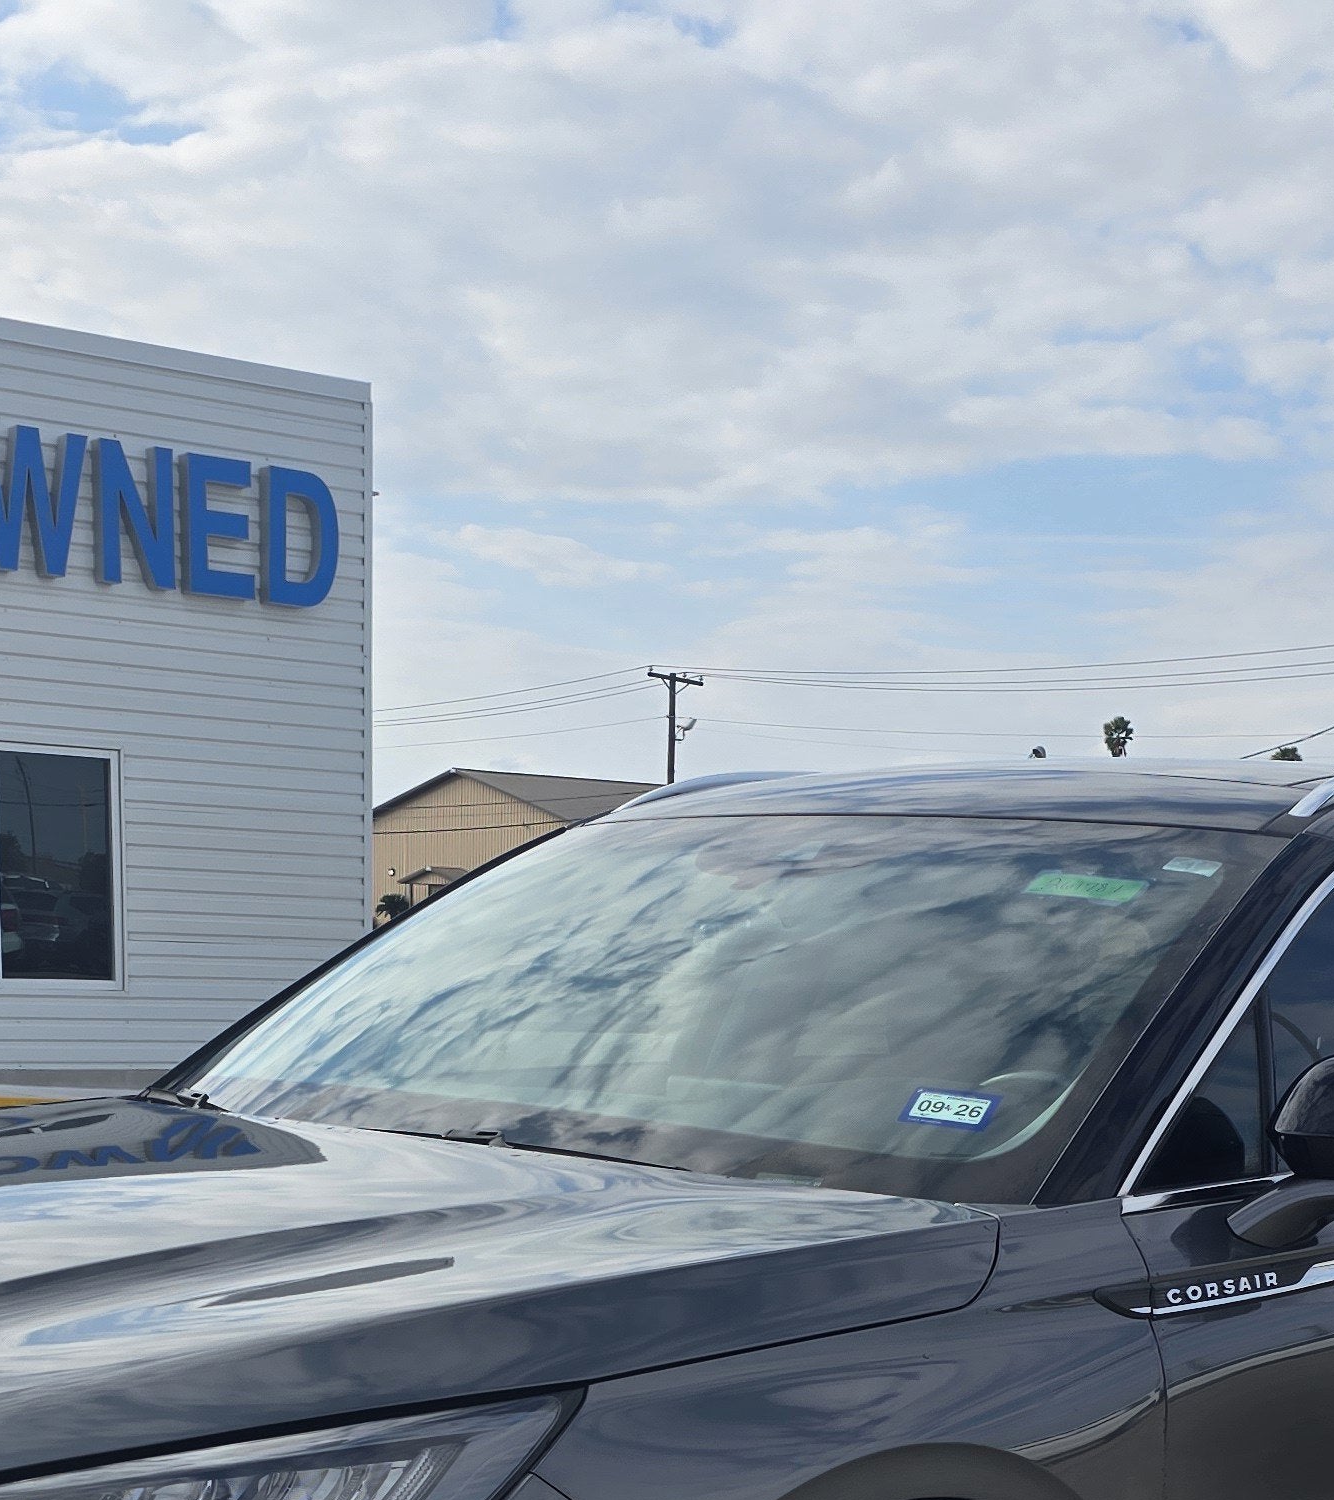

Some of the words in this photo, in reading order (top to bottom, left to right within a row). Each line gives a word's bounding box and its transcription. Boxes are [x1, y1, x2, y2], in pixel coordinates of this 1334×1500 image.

[917, 1100, 945, 1114] 09
[953, 1104, 984, 1119] 26
[1166, 1271, 1278, 1304] CORSAIR
